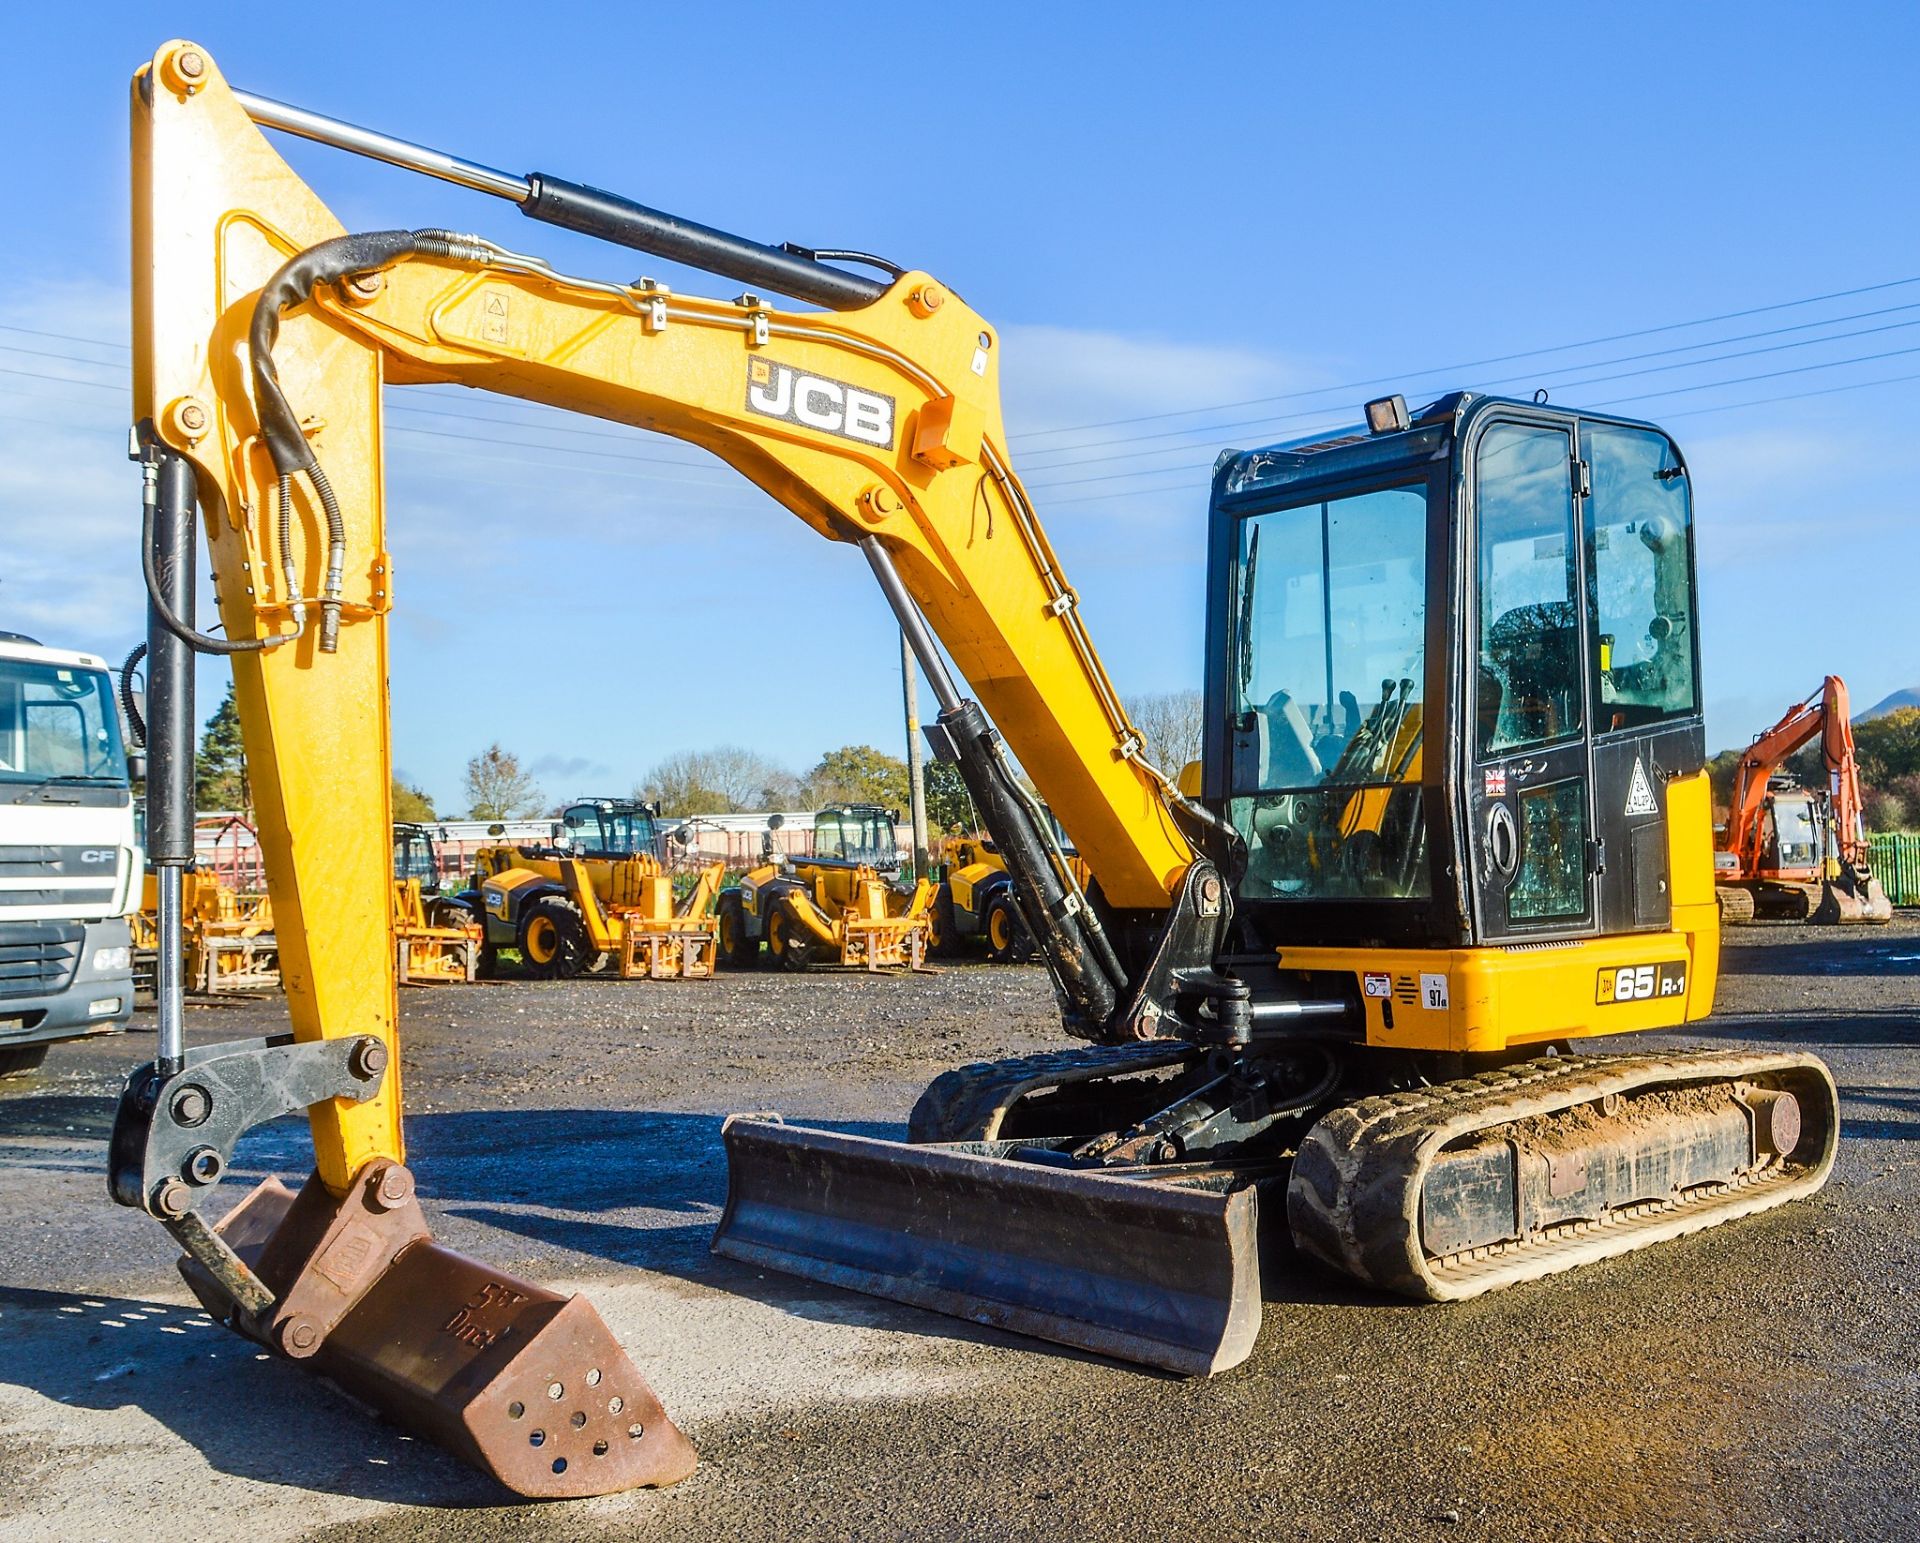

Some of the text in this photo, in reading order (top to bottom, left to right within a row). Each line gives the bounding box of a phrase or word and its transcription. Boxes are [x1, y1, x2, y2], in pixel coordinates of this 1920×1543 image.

[750, 368, 892, 444] JCB
[81, 850, 115, 862] CF
[487, 893, 502, 905] JCB
[1614, 966, 1655, 1000] 65
